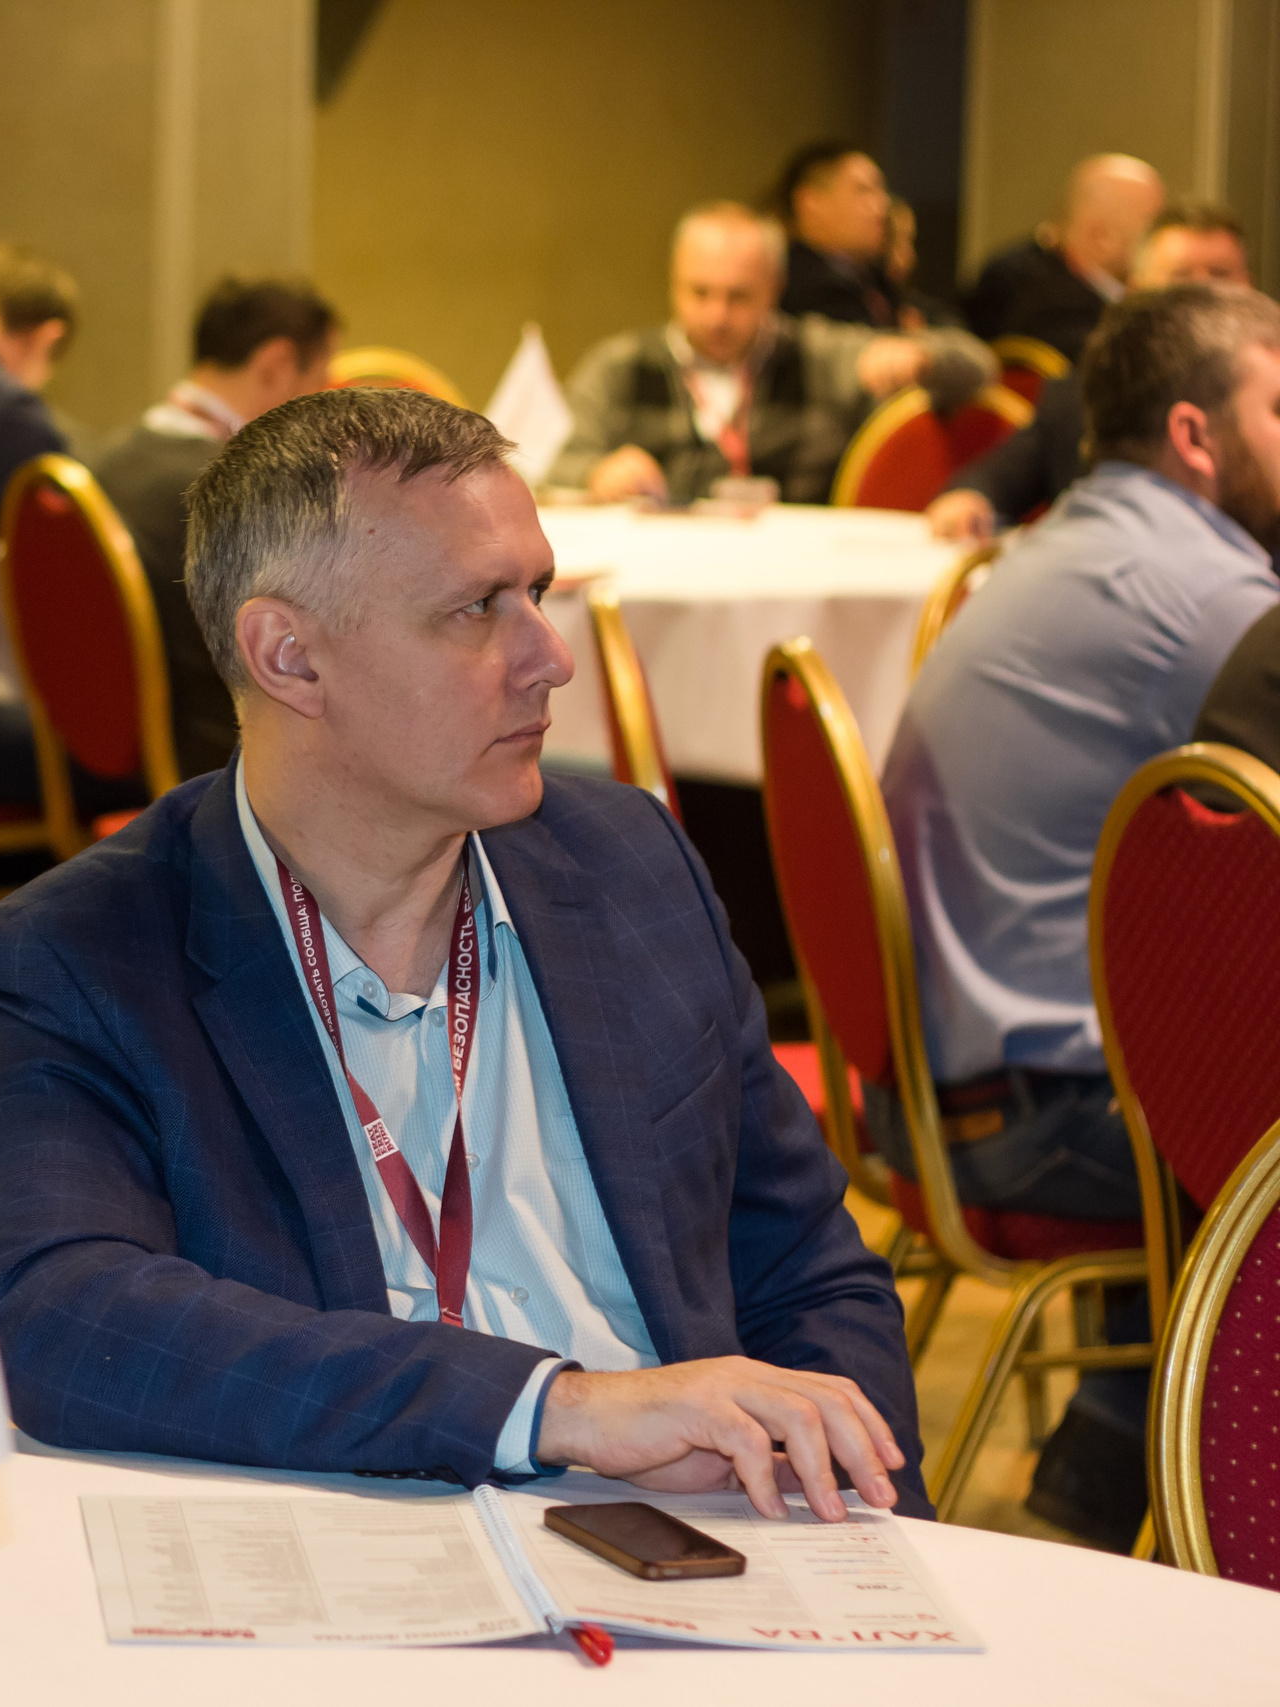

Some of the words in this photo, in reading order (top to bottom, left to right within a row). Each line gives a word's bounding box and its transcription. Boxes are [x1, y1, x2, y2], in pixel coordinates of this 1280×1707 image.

[297, 904, 317, 966] СООБЩА:
[313, 968, 335, 1032] РАБОТАТЬ
[452, 916, 474, 1071] БЕЗОПАСНОСТЬ
